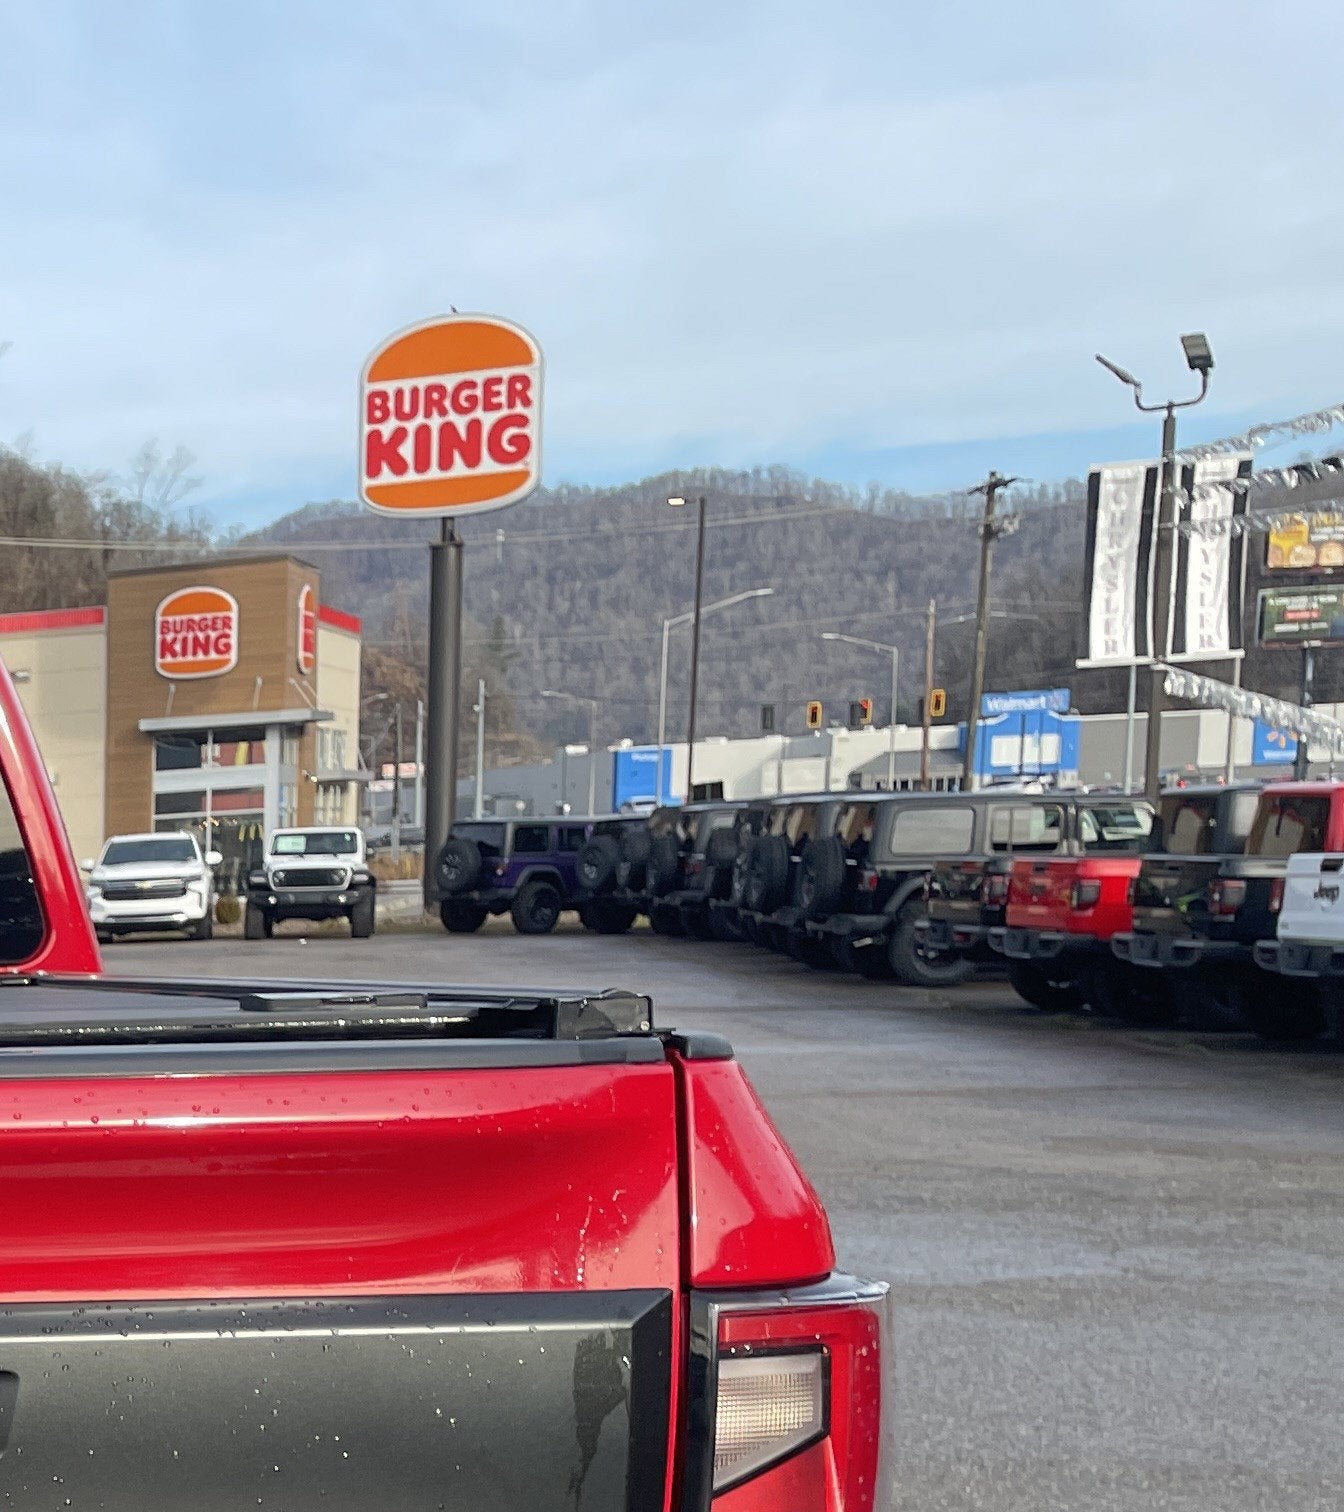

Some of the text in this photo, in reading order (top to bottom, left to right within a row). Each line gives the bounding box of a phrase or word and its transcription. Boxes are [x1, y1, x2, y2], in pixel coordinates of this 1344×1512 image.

[366, 373, 533, 425] BURGER
[365, 413, 531, 479] KING
[159, 615, 232, 635] BURGER
[159, 633, 232, 659] KING
